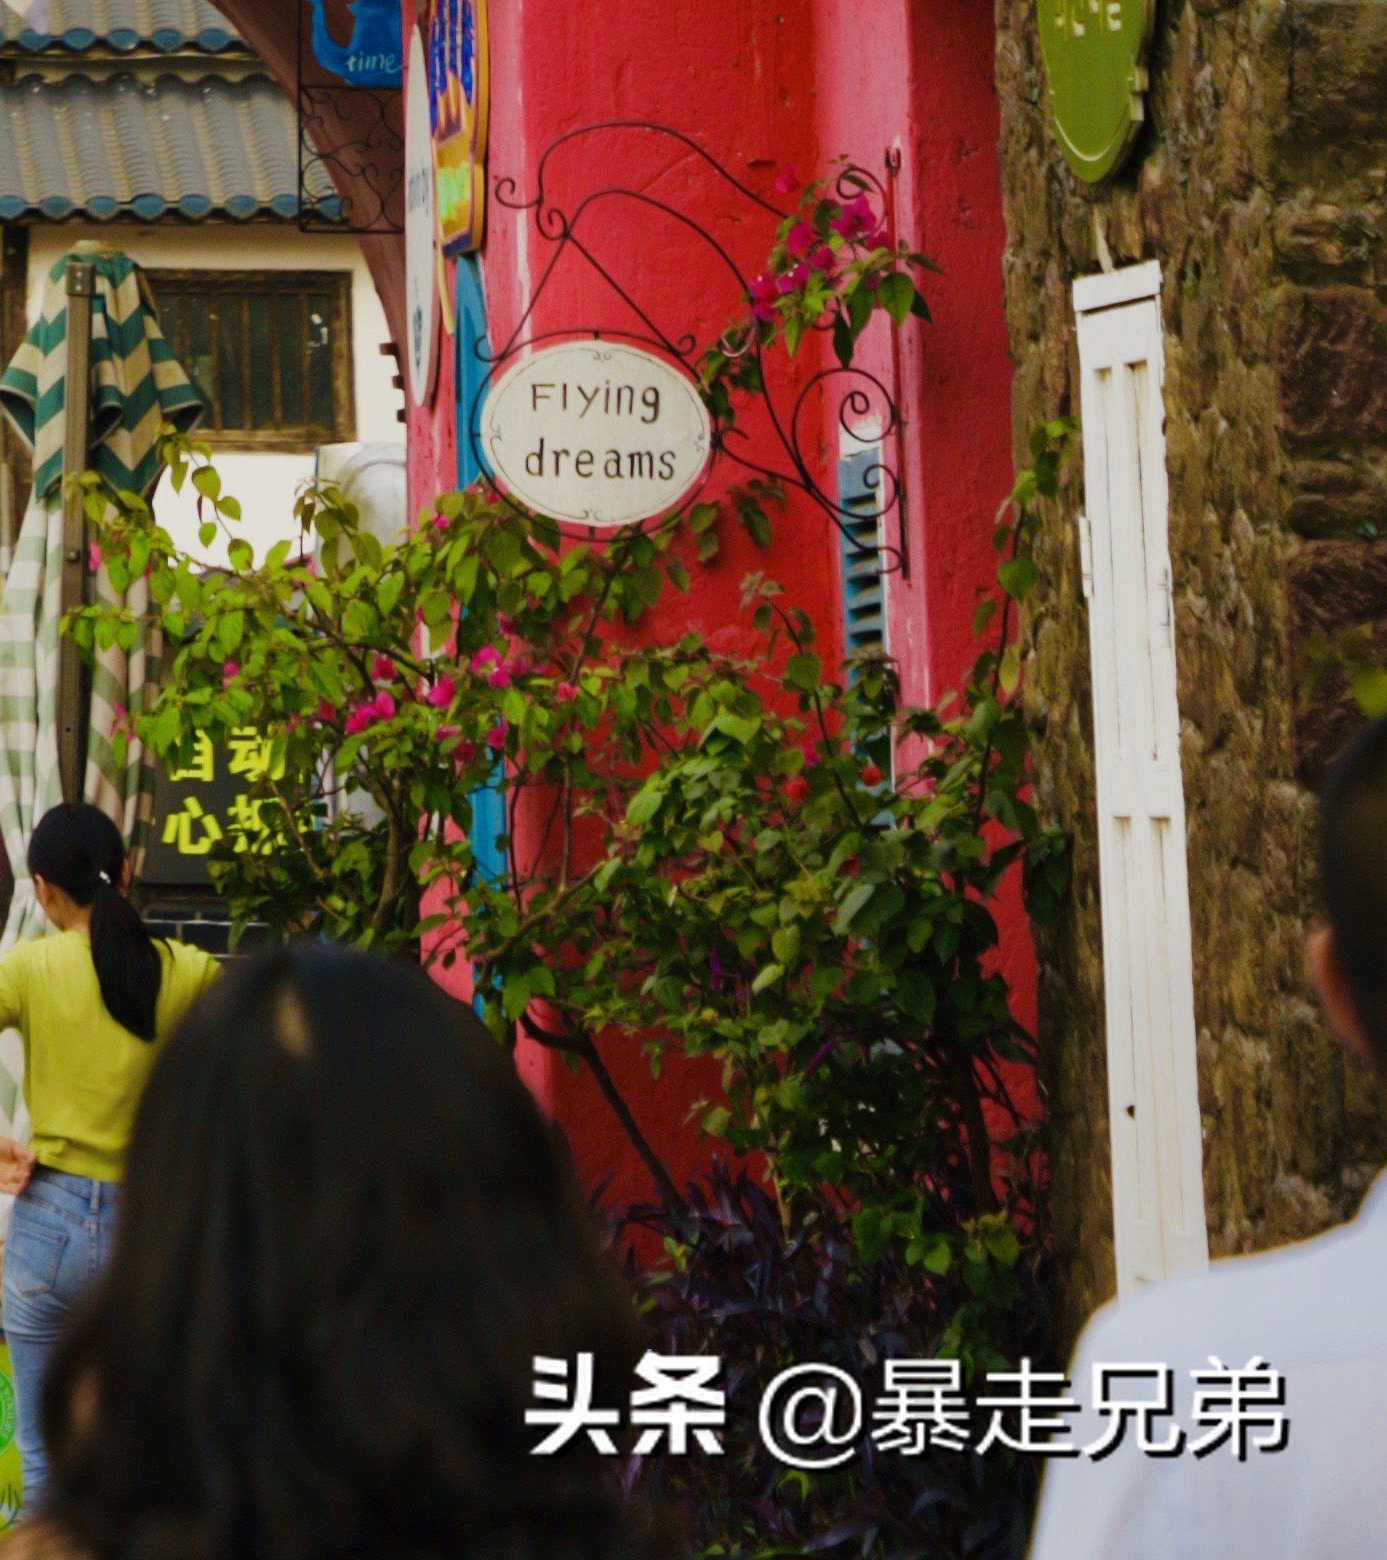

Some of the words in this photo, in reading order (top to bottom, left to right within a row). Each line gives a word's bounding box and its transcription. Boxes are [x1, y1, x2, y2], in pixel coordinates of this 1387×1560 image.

[345, 51, 402, 74] time
[531, 380, 660, 424] Flying
[525, 438, 676, 481] dreams
